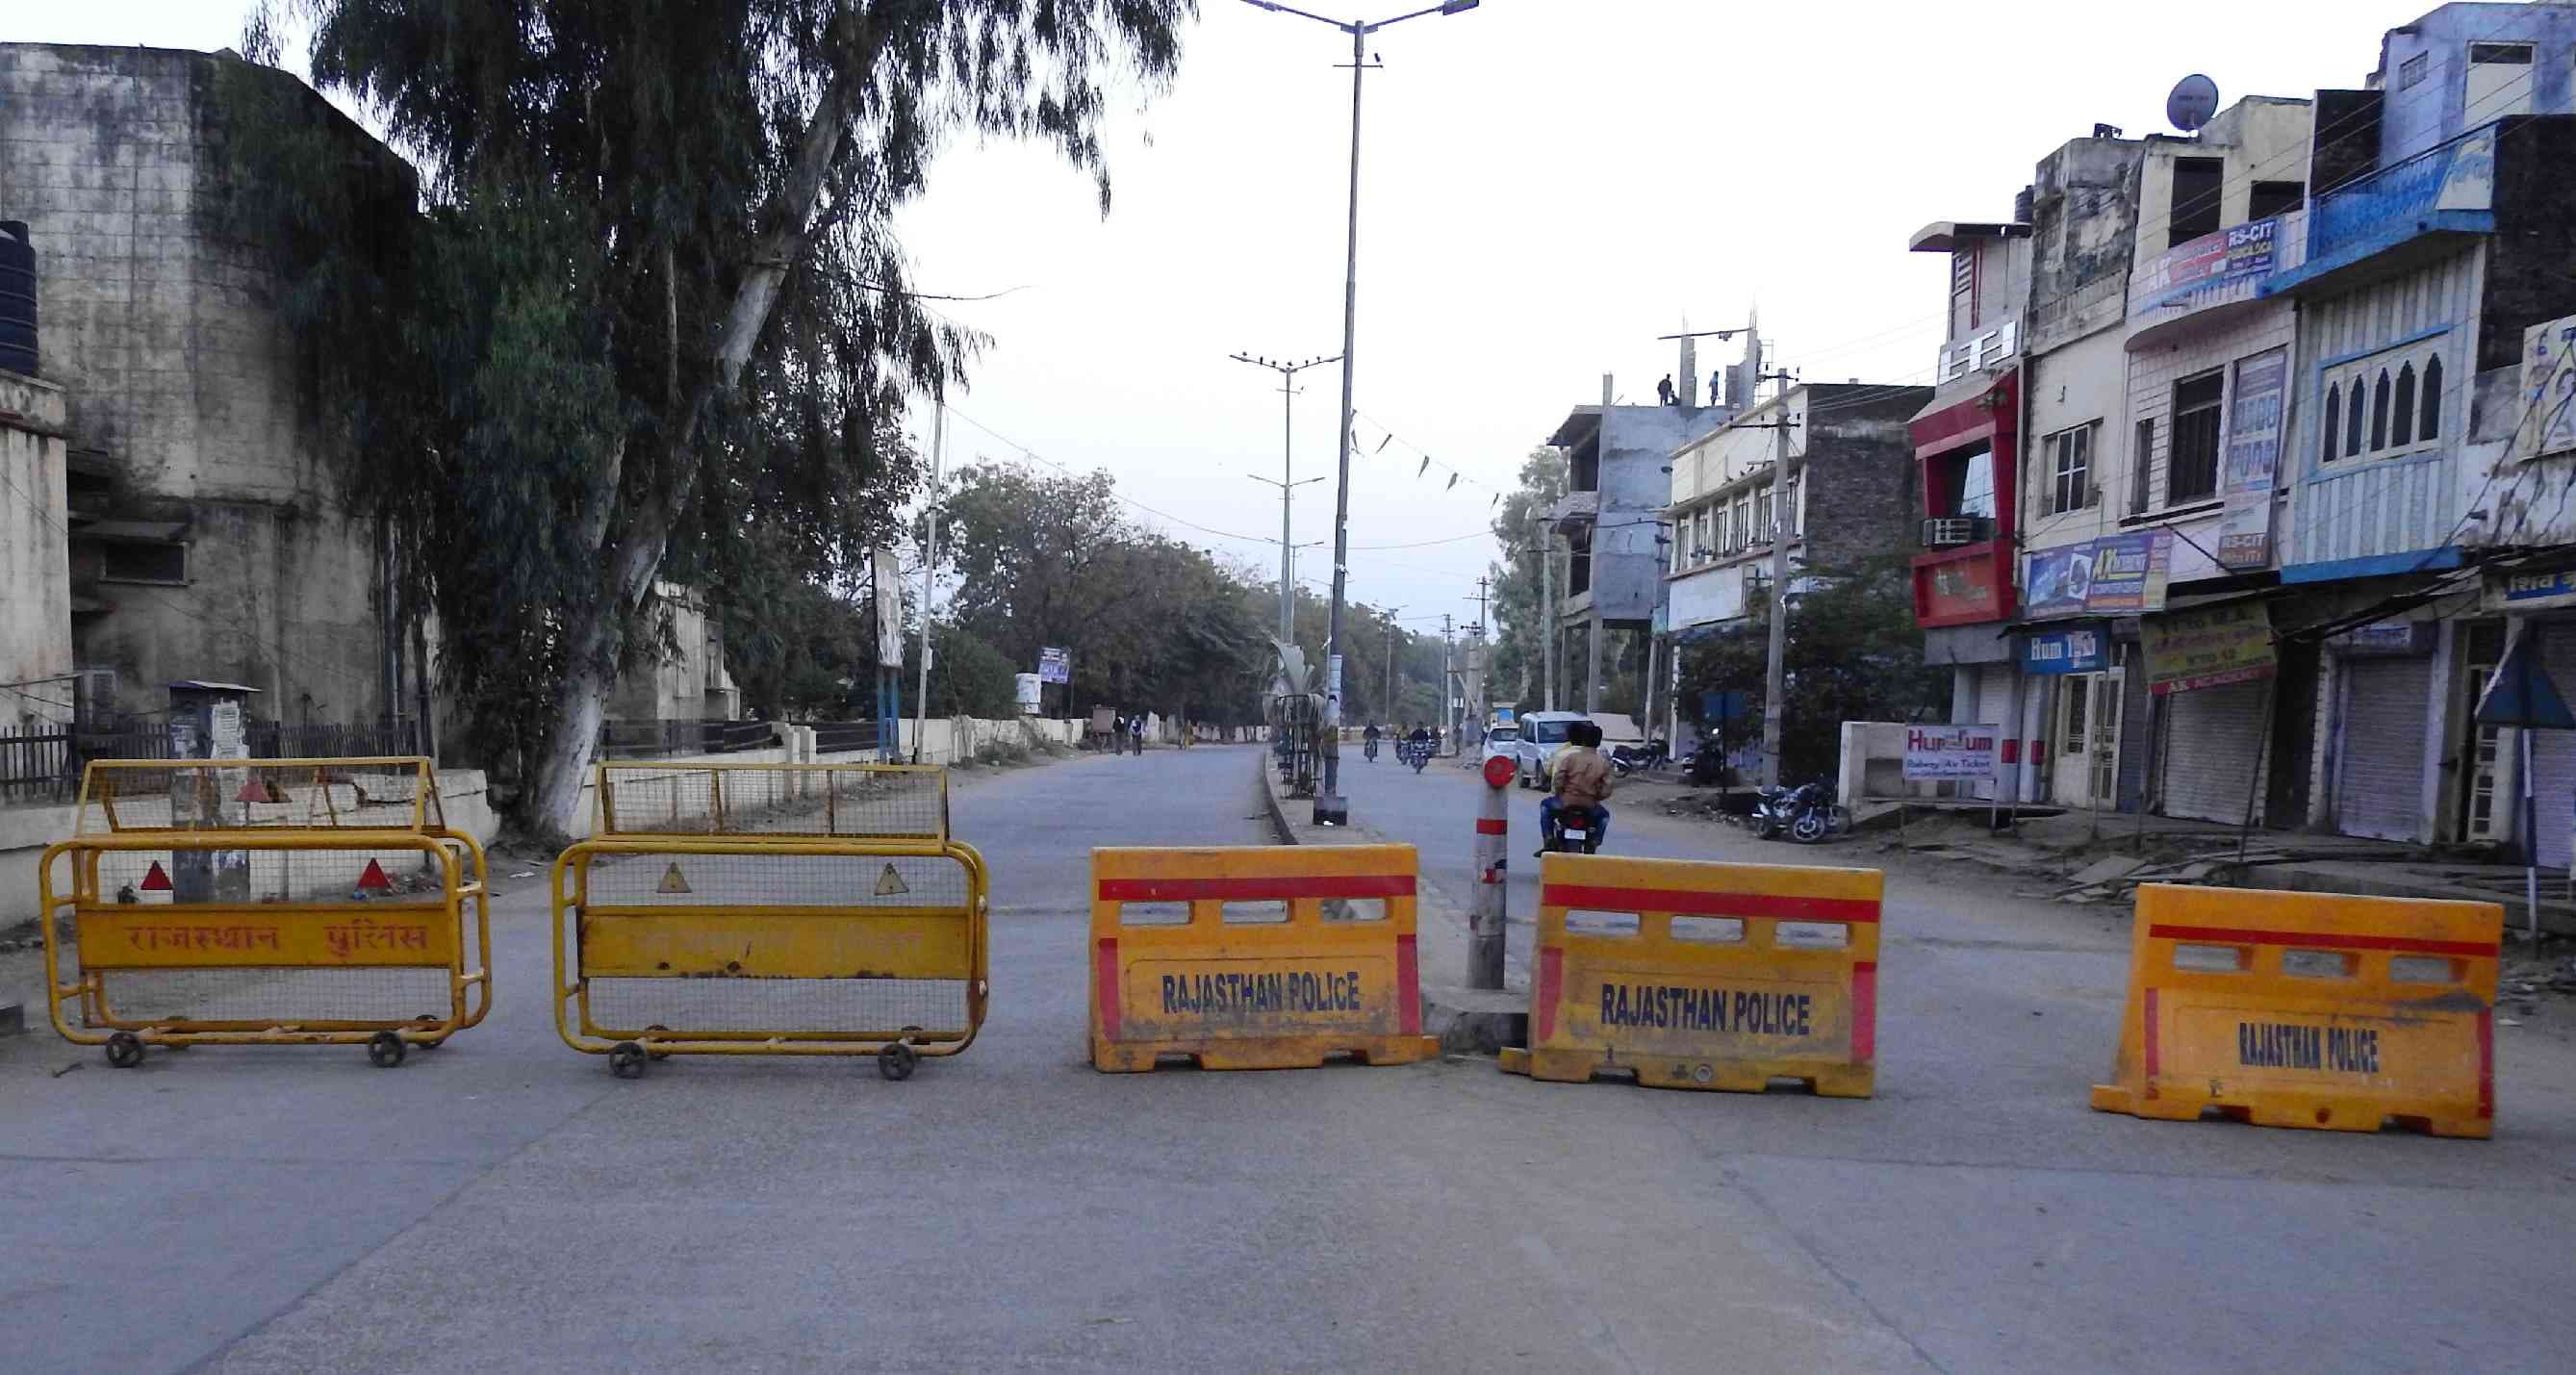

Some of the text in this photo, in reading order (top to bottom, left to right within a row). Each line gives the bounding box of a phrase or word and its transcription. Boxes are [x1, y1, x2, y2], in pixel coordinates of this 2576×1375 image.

[2031, 637, 2062, 661] Hum
[124, 918, 427, 957] राजस्थान पुलिस
[1162, 971, 1360, 1014] RAJASTHAN POLICE
[1601, 983, 1810, 1036] RAJASTHAN POLICE
[2239, 1022, 2380, 1073] RAJASTHAN POLICE
